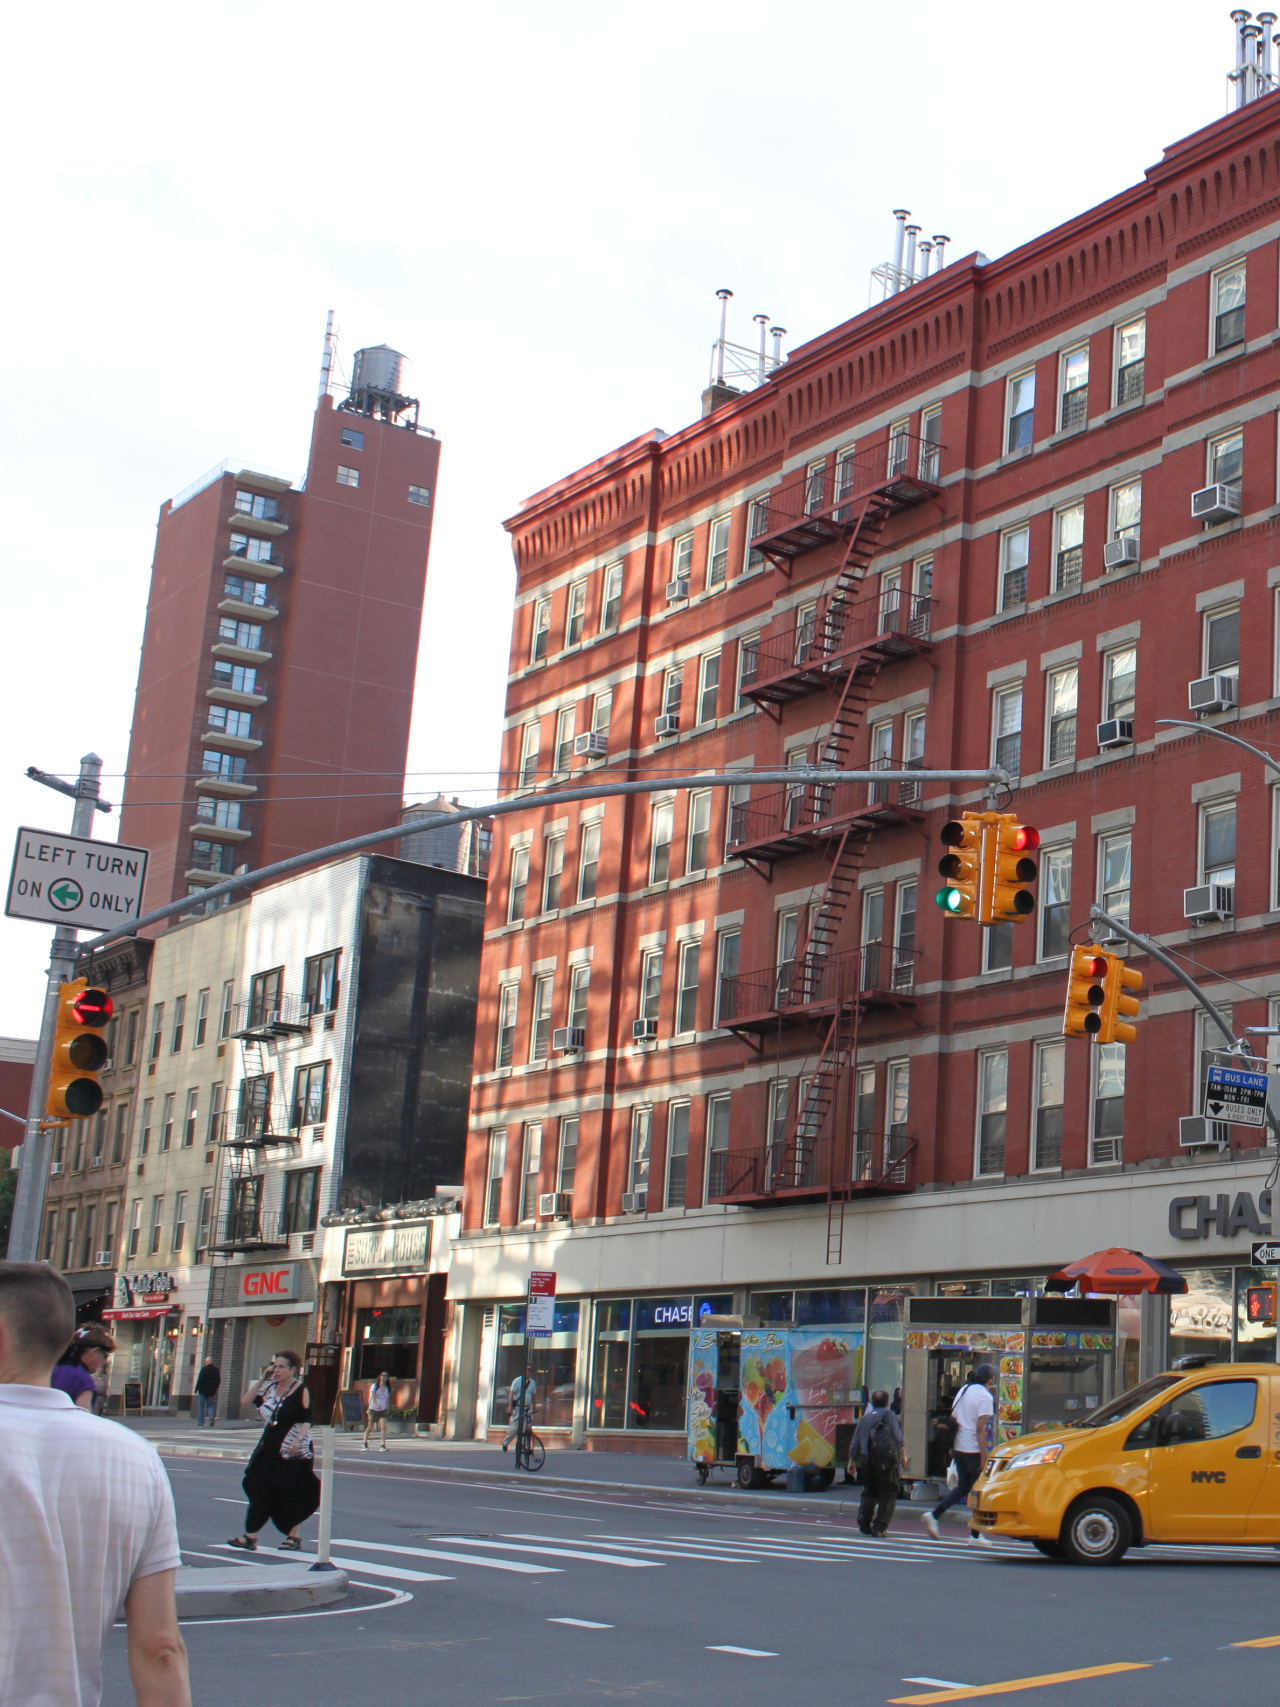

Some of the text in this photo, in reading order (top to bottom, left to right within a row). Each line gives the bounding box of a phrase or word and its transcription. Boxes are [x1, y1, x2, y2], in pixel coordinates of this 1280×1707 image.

[25, 842, 138, 877] LEFT TURN
[17, 879, 135, 913] ON ONLY
[1224, 1073, 1264, 1087] BUS LANE
[1240, 1096, 1250, 1104] FRI
[1226, 1104, 1263, 1116] BUSES ONLY
[393, 1230, 426, 1262] HOUSE
[1260, 1249, 1275, 1259] ONE
[243, 1270, 289, 1296] GNC
[1191, 1471, 1226, 1483] NYC
